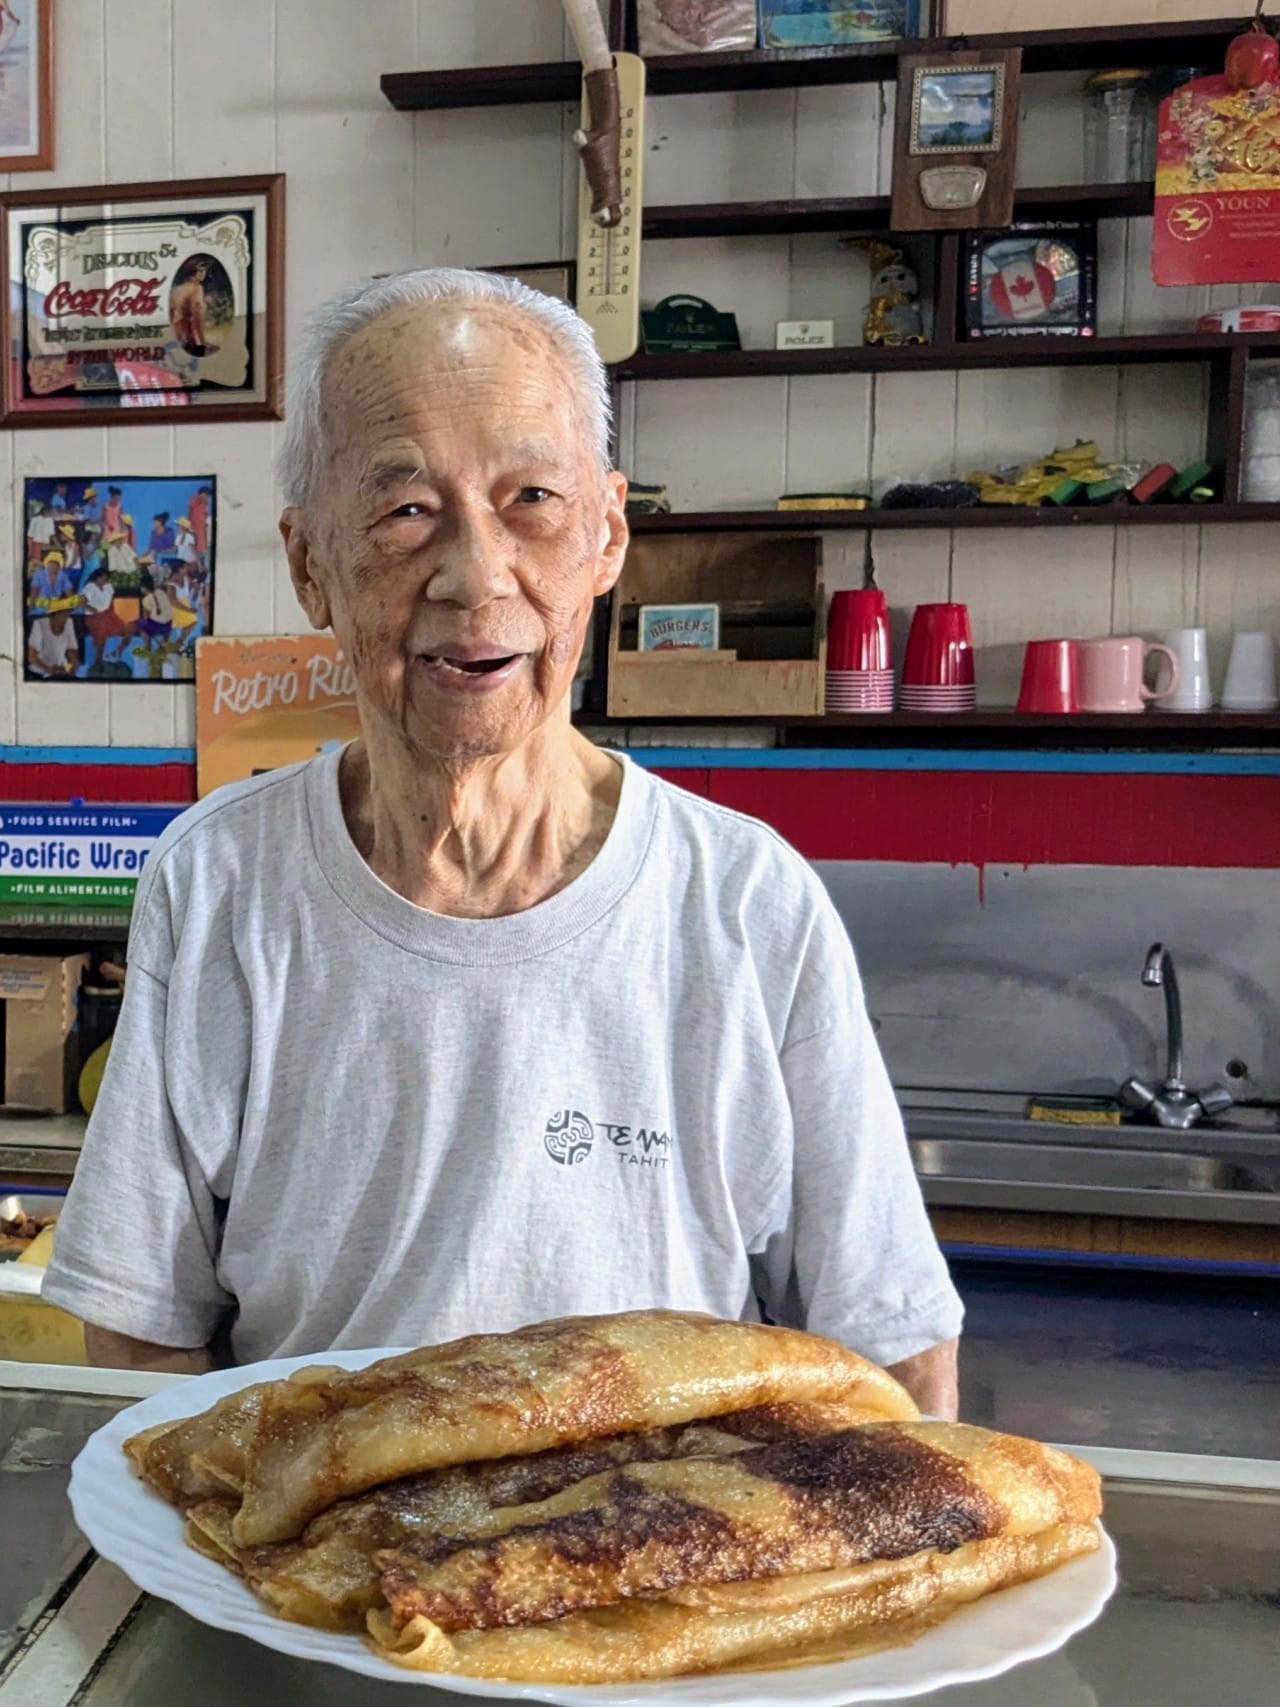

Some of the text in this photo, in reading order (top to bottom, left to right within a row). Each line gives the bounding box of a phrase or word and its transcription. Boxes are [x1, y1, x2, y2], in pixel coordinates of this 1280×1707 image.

[82, 251, 159, 274] DELICIOUS
[44, 276, 167, 318] Coca-Cola
[110, 346, 166, 362] WORLD
[650, 619, 710, 638] BURGERS
[211, 669, 299, 715] Retro
[13, 816, 131, 827] FOOD SERVICE FILM
[16, 883, 129, 896] FILM ALIMENTAIRE
